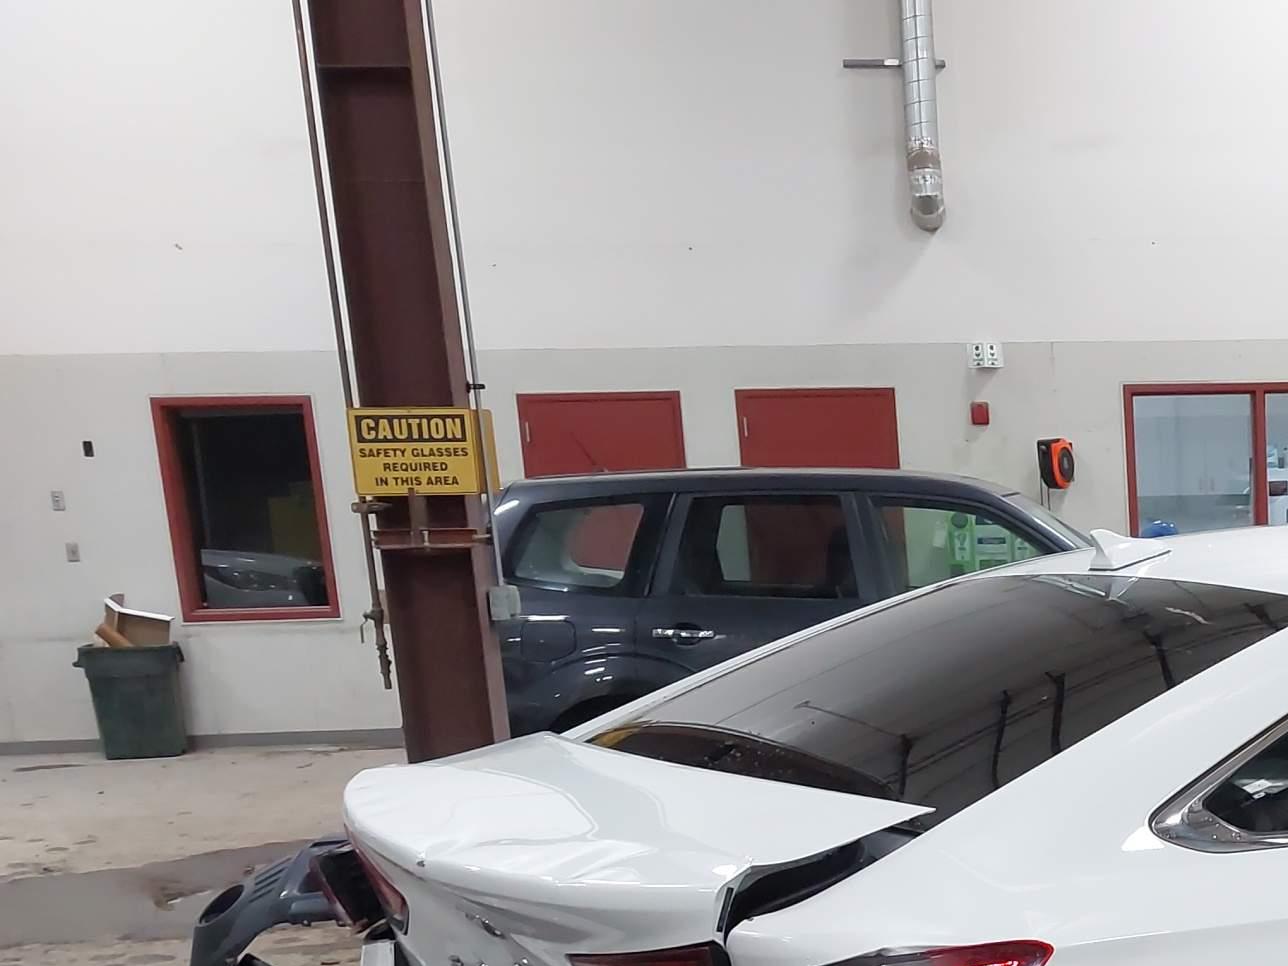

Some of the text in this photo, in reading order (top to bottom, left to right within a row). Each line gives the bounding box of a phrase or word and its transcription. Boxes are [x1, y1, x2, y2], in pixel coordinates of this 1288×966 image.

[360, 417, 463, 440] CAUTION
[359, 447, 469, 458] SAFETY GLASSES
[383, 461, 448, 472] REQUIRED
[375, 476, 459, 487] IN THIS AREA
